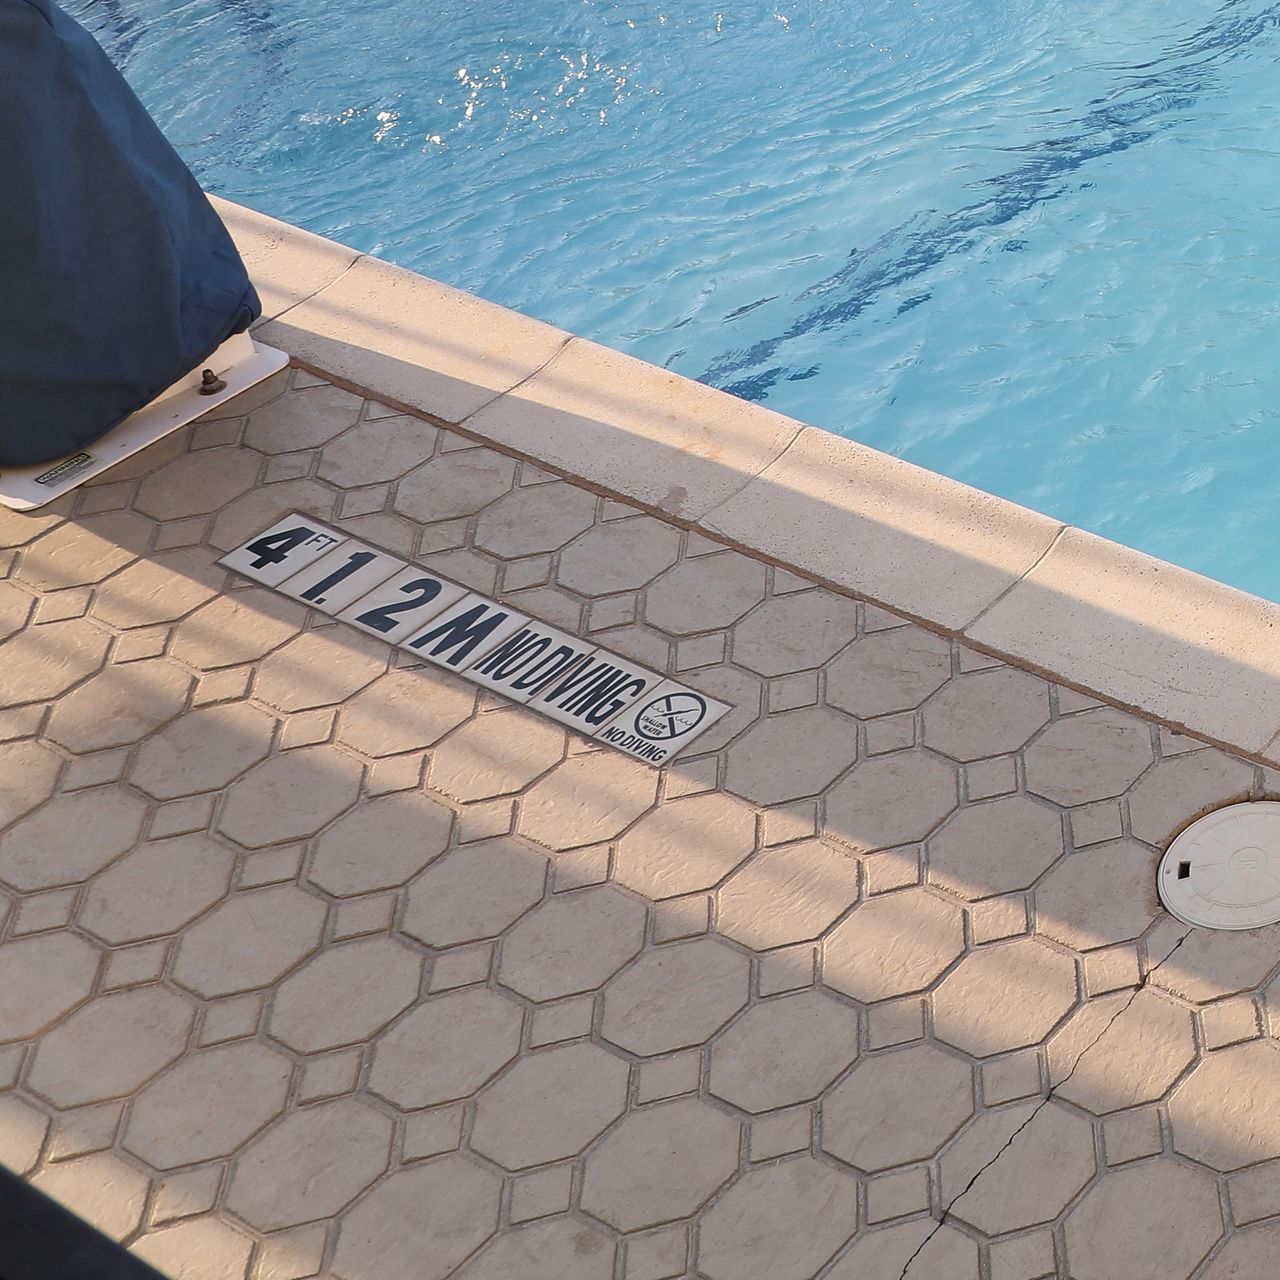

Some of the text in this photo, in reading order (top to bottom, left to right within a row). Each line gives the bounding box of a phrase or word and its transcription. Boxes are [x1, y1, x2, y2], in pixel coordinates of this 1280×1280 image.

[473, 628, 541, 681] NO
[511, 645, 646, 726] DIVING
[641, 715, 668, 730] SHALLOW
[642, 724, 662, 736] WATER
[601, 726, 667, 762] NO DIVING
